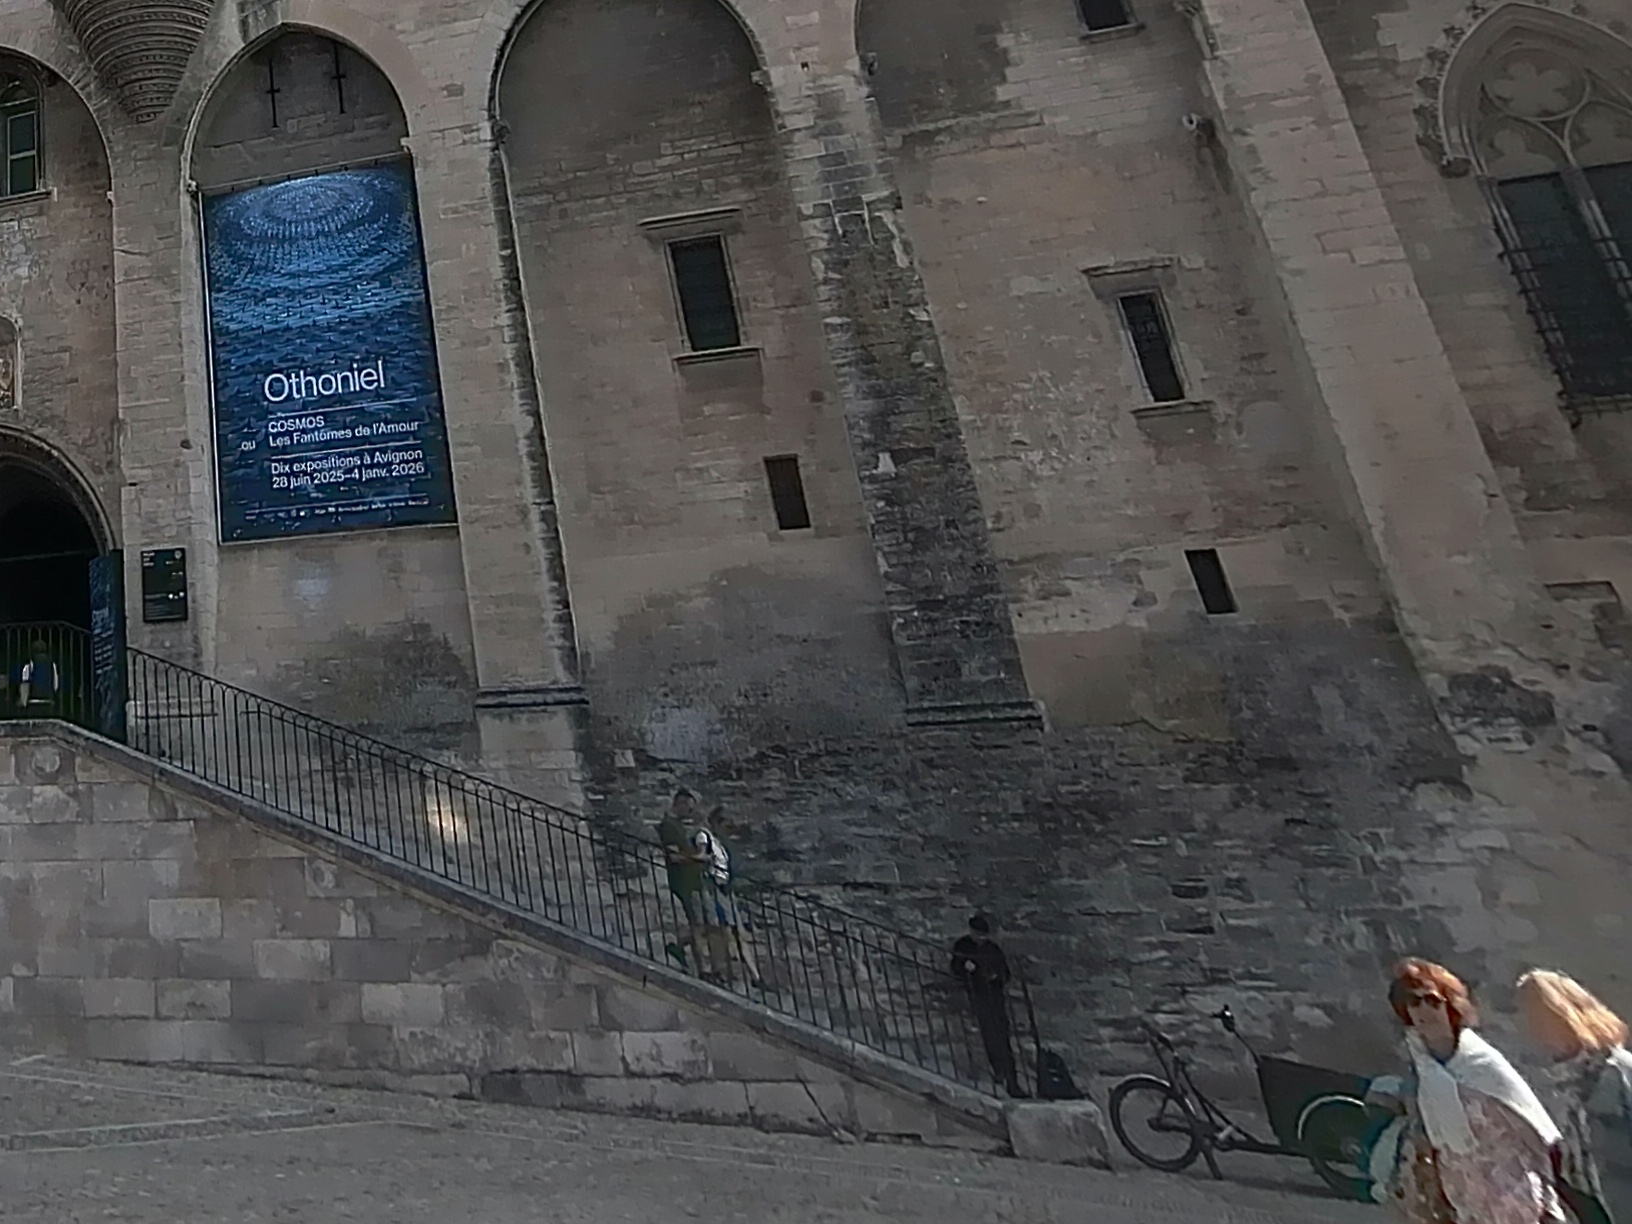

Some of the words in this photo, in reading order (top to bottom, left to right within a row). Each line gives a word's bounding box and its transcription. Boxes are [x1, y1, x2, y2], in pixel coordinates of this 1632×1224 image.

[264, 360, 385, 402] Othoniel
[269, 415, 325, 432] COSMOS
[269, 435, 291, 447] Les
[355, 424, 370, 436] de
[271, 461, 291, 474] Dix
[293, 455, 361, 473] expositions
[363, 452, 371, 464] à
[373, 449, 423, 464] Avignon
[272, 476, 288, 489] 28
[289, 473, 311, 489] juin
[362, 467, 389, 482] janv.
[391, 461, 425, 476] 2026
